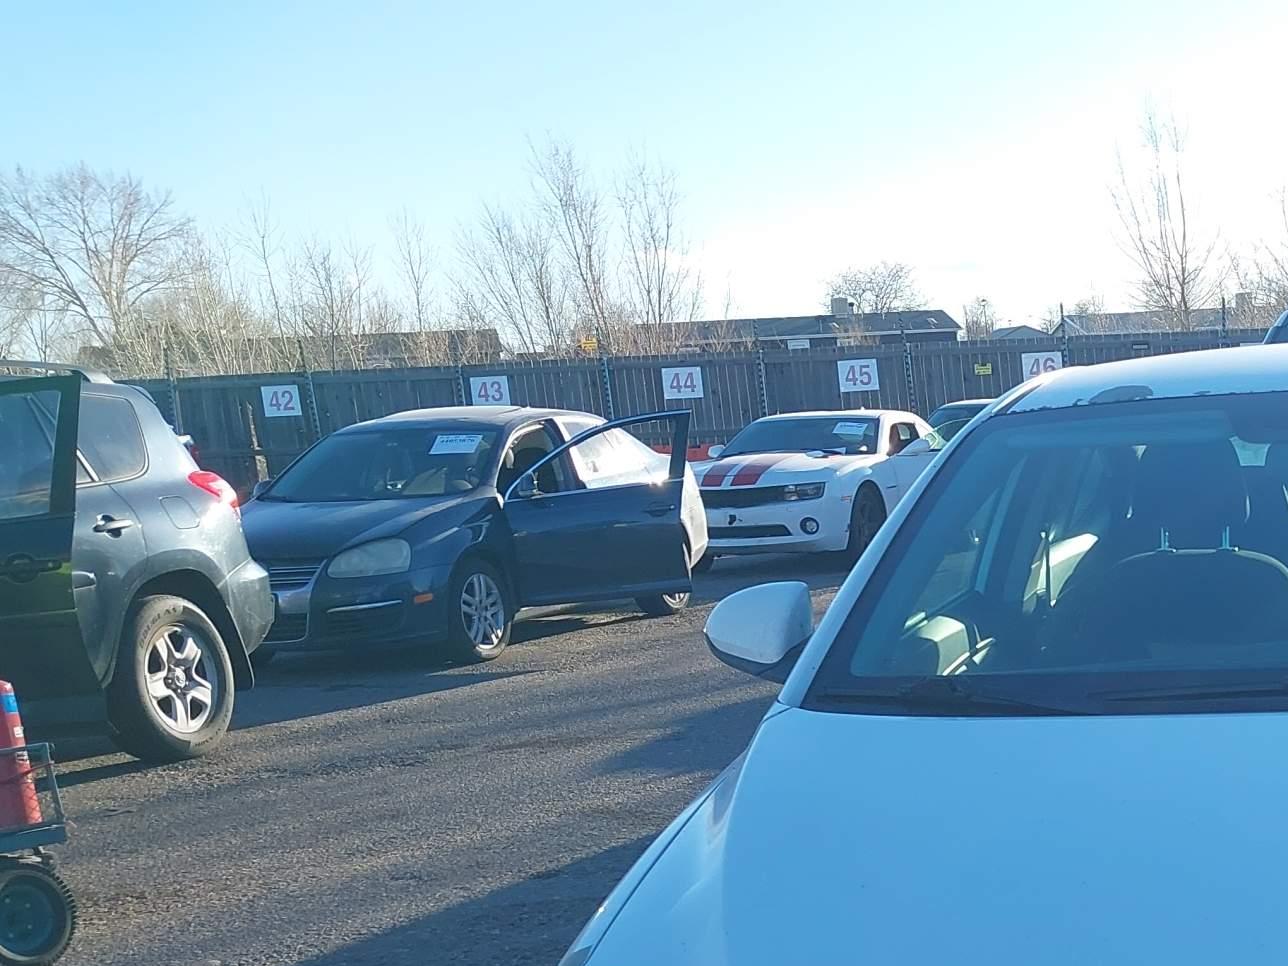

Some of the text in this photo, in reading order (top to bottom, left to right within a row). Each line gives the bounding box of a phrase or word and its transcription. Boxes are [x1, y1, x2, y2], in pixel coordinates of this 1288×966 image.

[845, 364, 872, 386] 45
[1029, 357, 1056, 376] 46
[477, 381, 504, 402] 43
[669, 371, 697, 393] 44
[269, 390, 295, 411] 42
